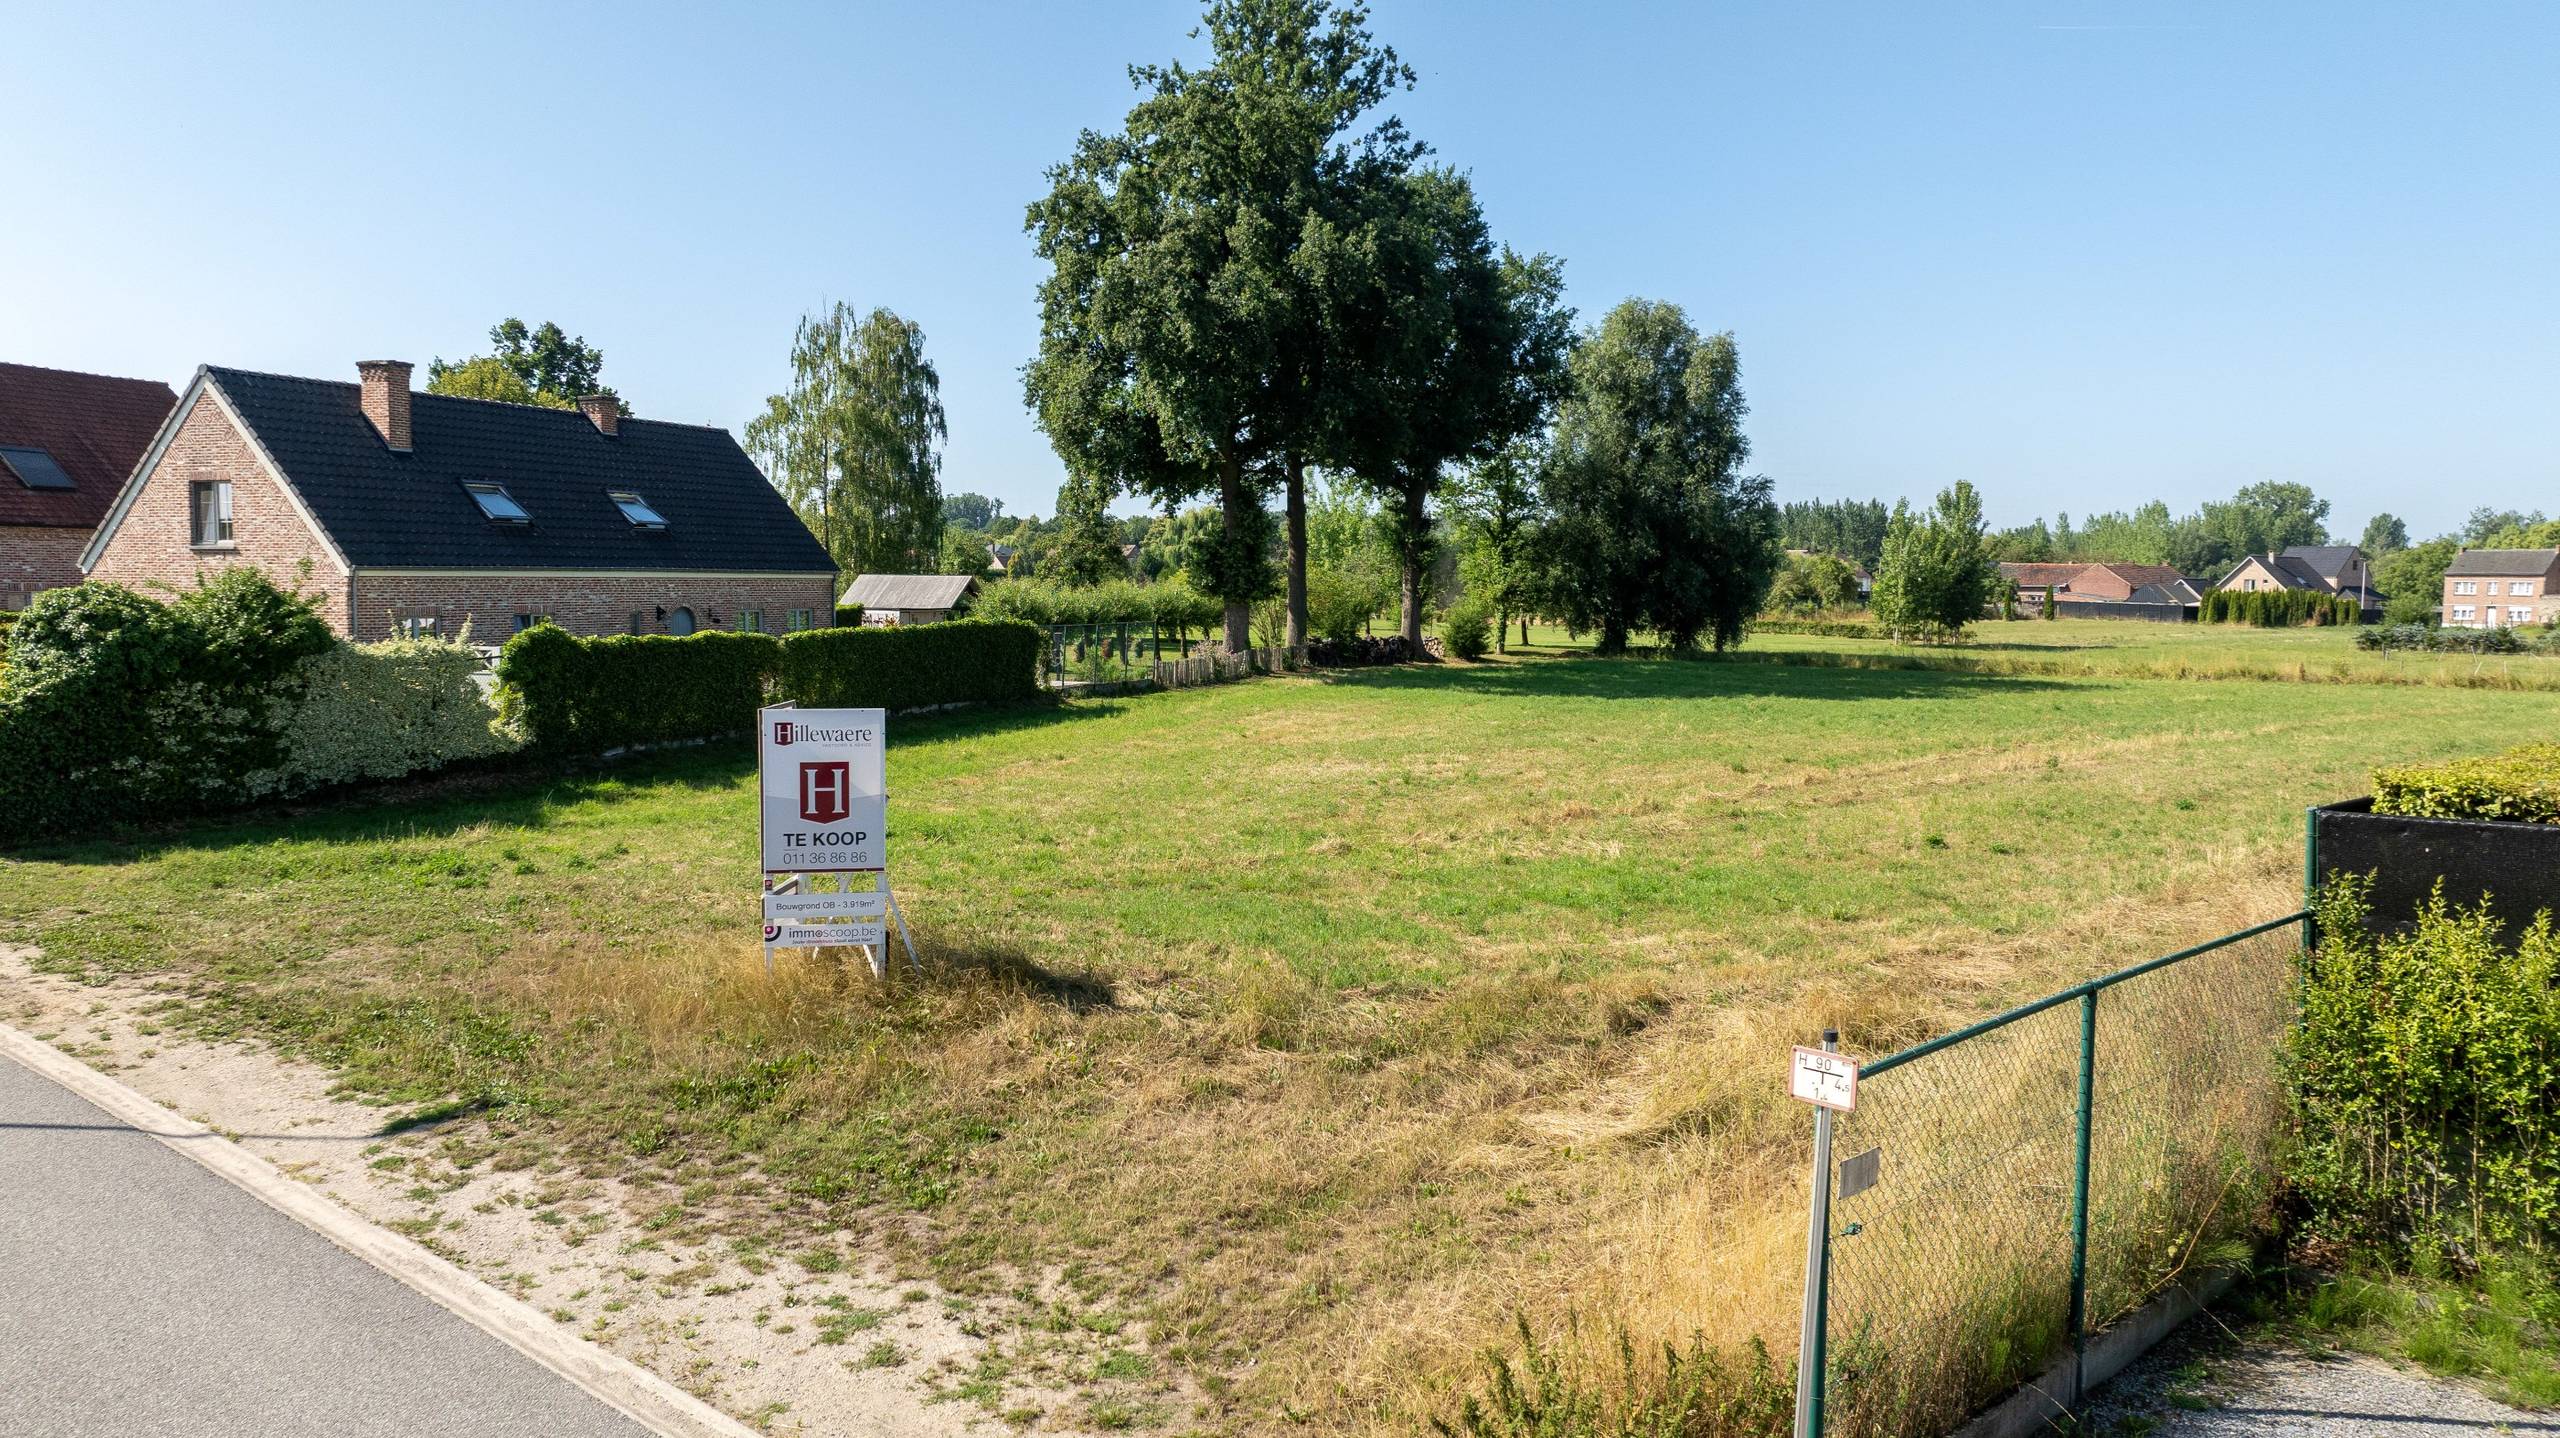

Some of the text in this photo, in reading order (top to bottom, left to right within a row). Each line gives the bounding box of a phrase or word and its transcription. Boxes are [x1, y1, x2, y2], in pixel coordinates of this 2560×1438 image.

[775, 723, 872, 743] Hillewaere
[804, 768, 846, 815] H
[783, 831, 867, 847] TE KOOP
[783, 851, 867, 865] 011 36 86 86
[776, 901, 820, 911] Bouwgrond
[822, 901, 836, 909] OB
[788, 925, 877, 939] immoscoop.be
[1798, 1053, 1808, 1066] H
[1816, 1057, 1832, 1071] 90
